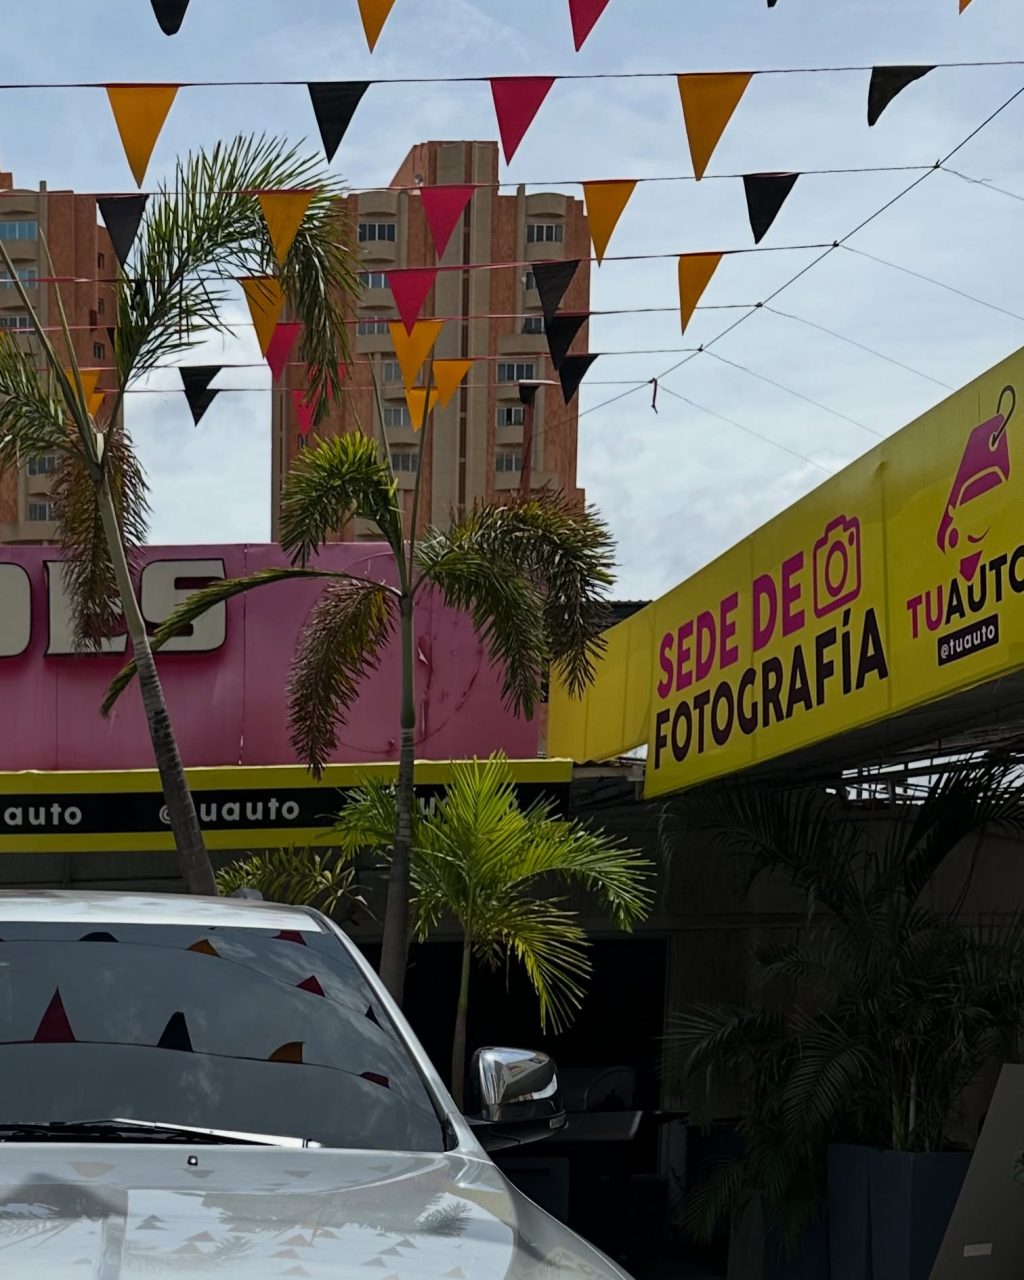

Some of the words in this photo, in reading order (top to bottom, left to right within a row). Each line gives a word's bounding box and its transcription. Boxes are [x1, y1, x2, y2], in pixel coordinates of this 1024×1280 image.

[657, 591, 739, 699] SEDE
[752, 551, 806, 653] DE
[940, 624, 996, 659] @tuauto
[654, 608, 889, 770] FOTOGRAFÍA
[158, 797, 301, 825] @uauto
